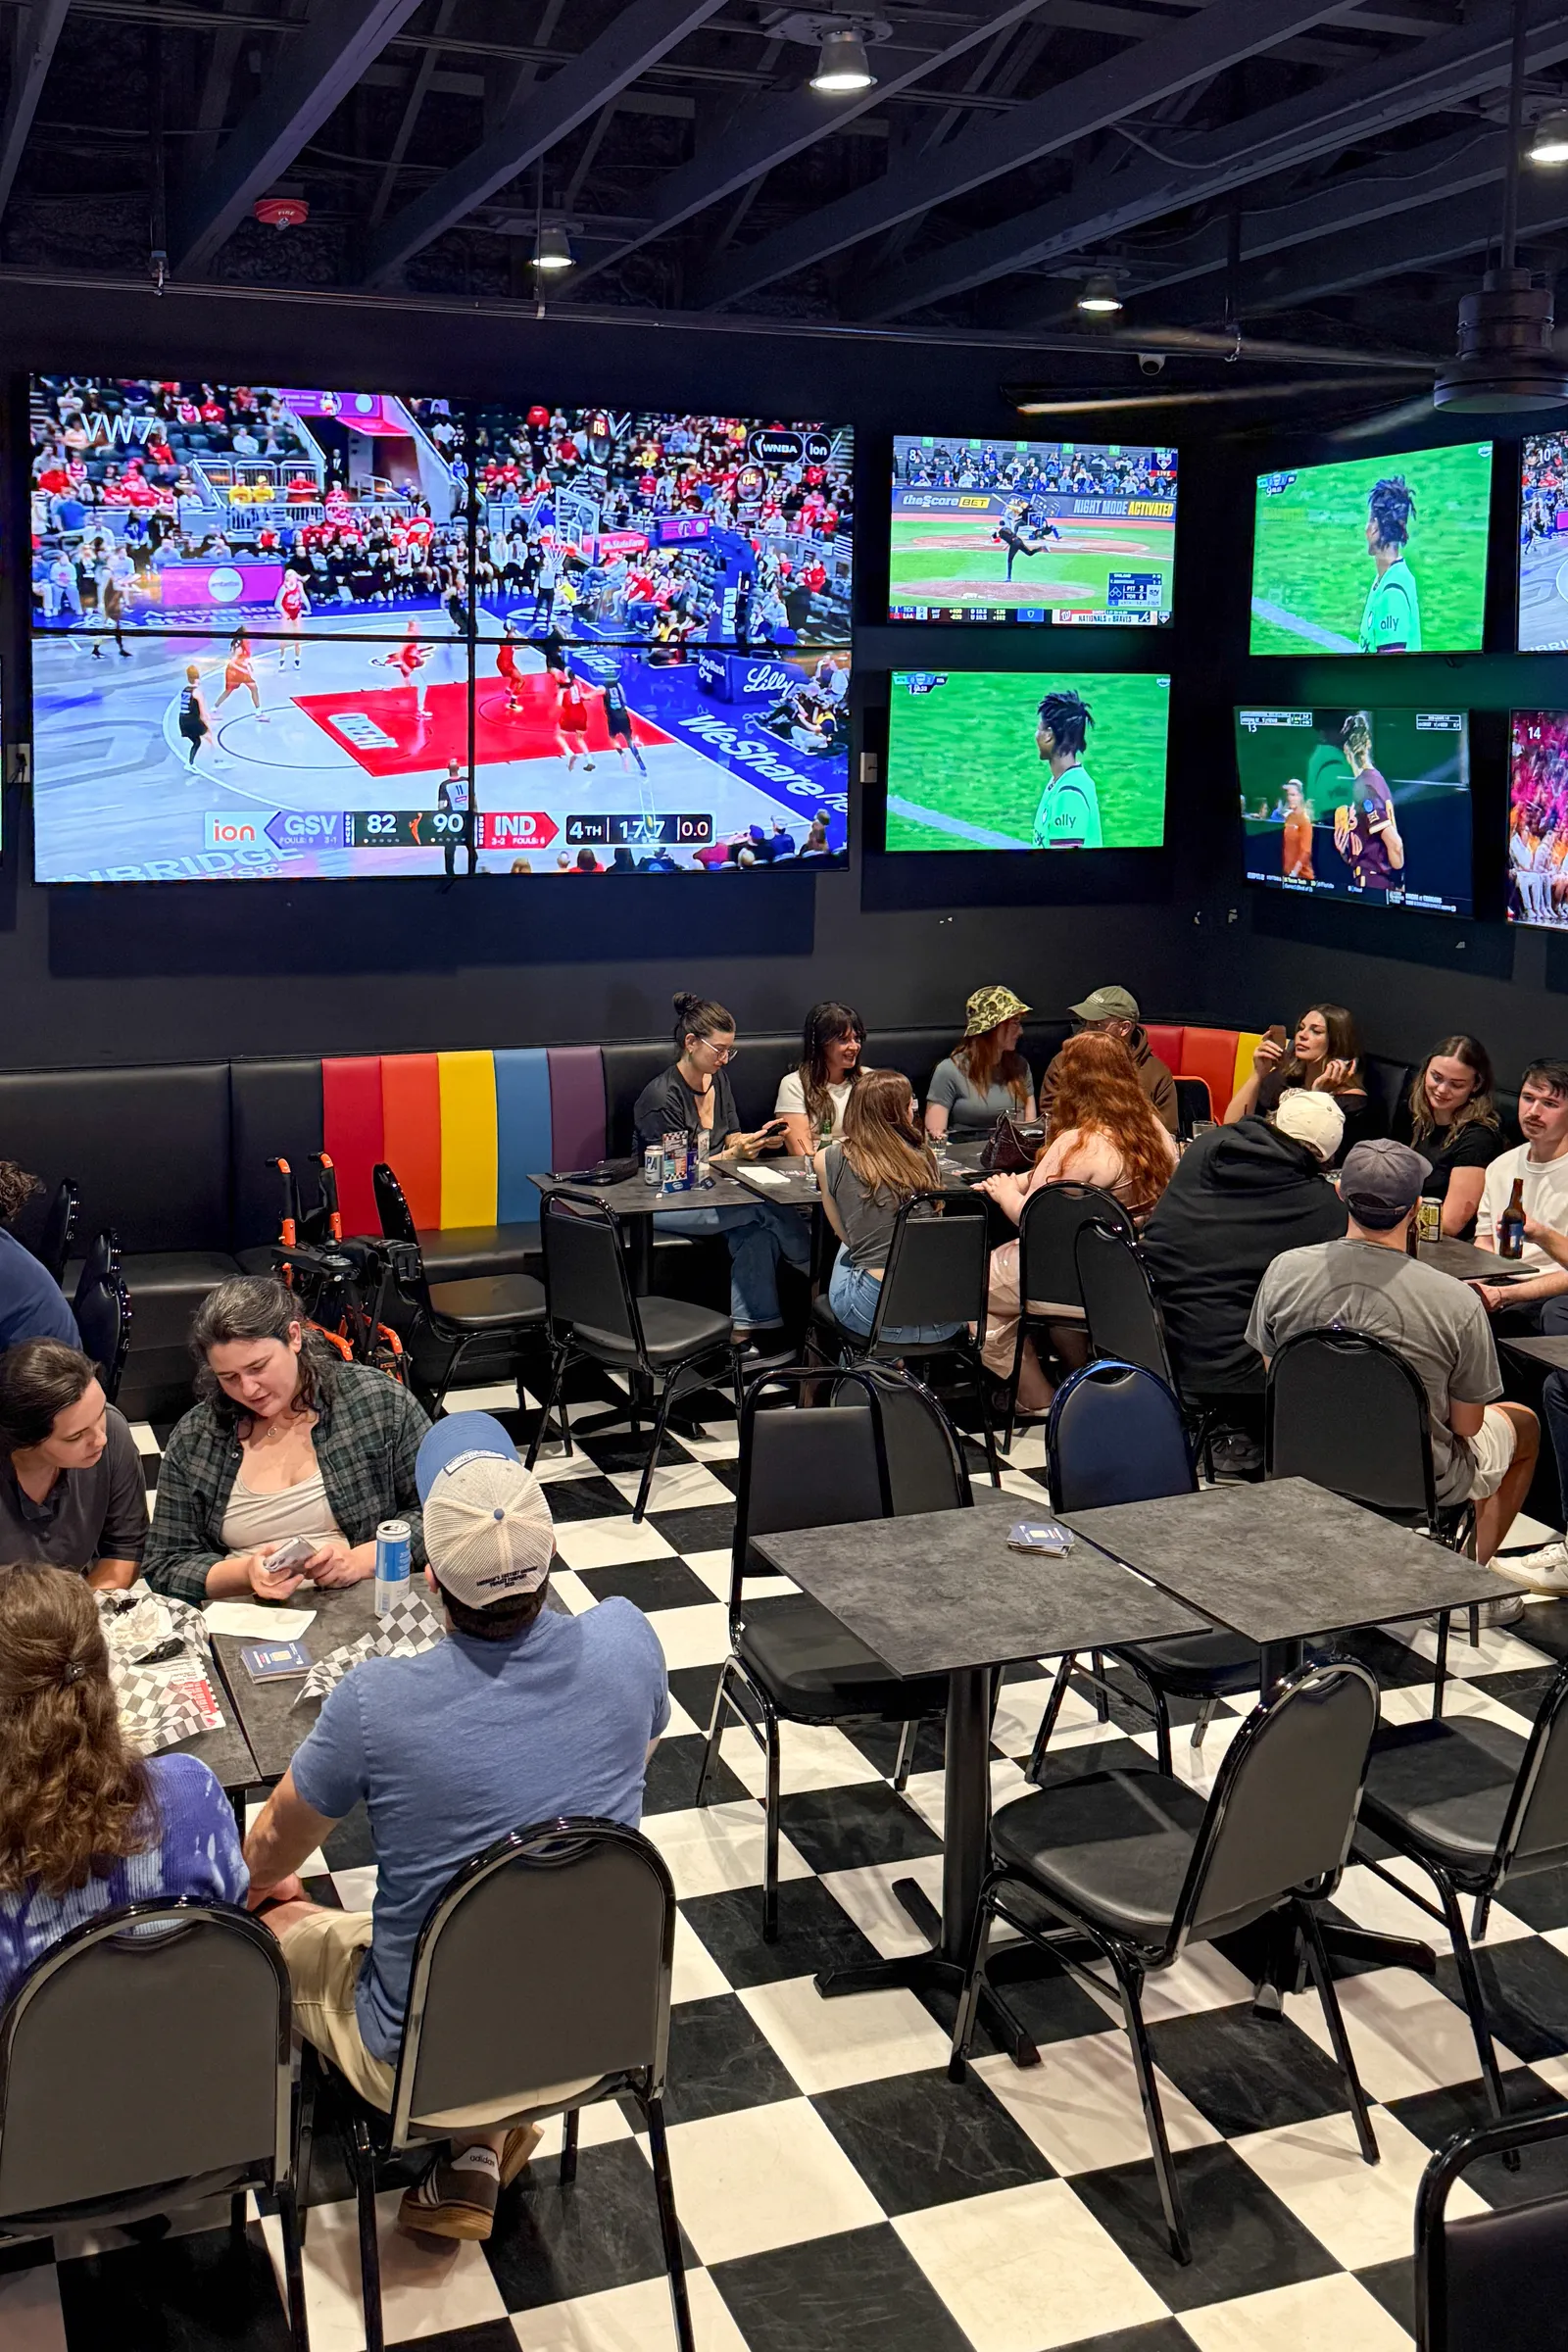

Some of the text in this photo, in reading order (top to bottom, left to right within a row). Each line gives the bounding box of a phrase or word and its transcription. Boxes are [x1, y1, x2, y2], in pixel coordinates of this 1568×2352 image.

[81, 413, 154, 444] VW7
[762, 444, 798, 455] WNBA
[808, 443, 827, 457] ion
[909, 449, 916, 462] 8
[1538, 448, 1551, 462] 10
[1073, 499, 1174, 517] NIGHT MODE ACTIVATED
[723, 588, 736, 635] RCA
[1380, 615, 1399, 631] ally
[743, 664, 795, 697] Lilly
[1528, 726, 1542, 740] 14
[284, 814, 338, 836] GSV
[367, 813, 397, 834] 82
[432, 812, 465, 833] 90
[494, 814, 536, 837] IND
[681, 821, 709, 837] 0.0
[1054, 813, 1077, 828] ally
[214, 818, 255, 842] ion
[491, 837, 506, 846] 3-2
